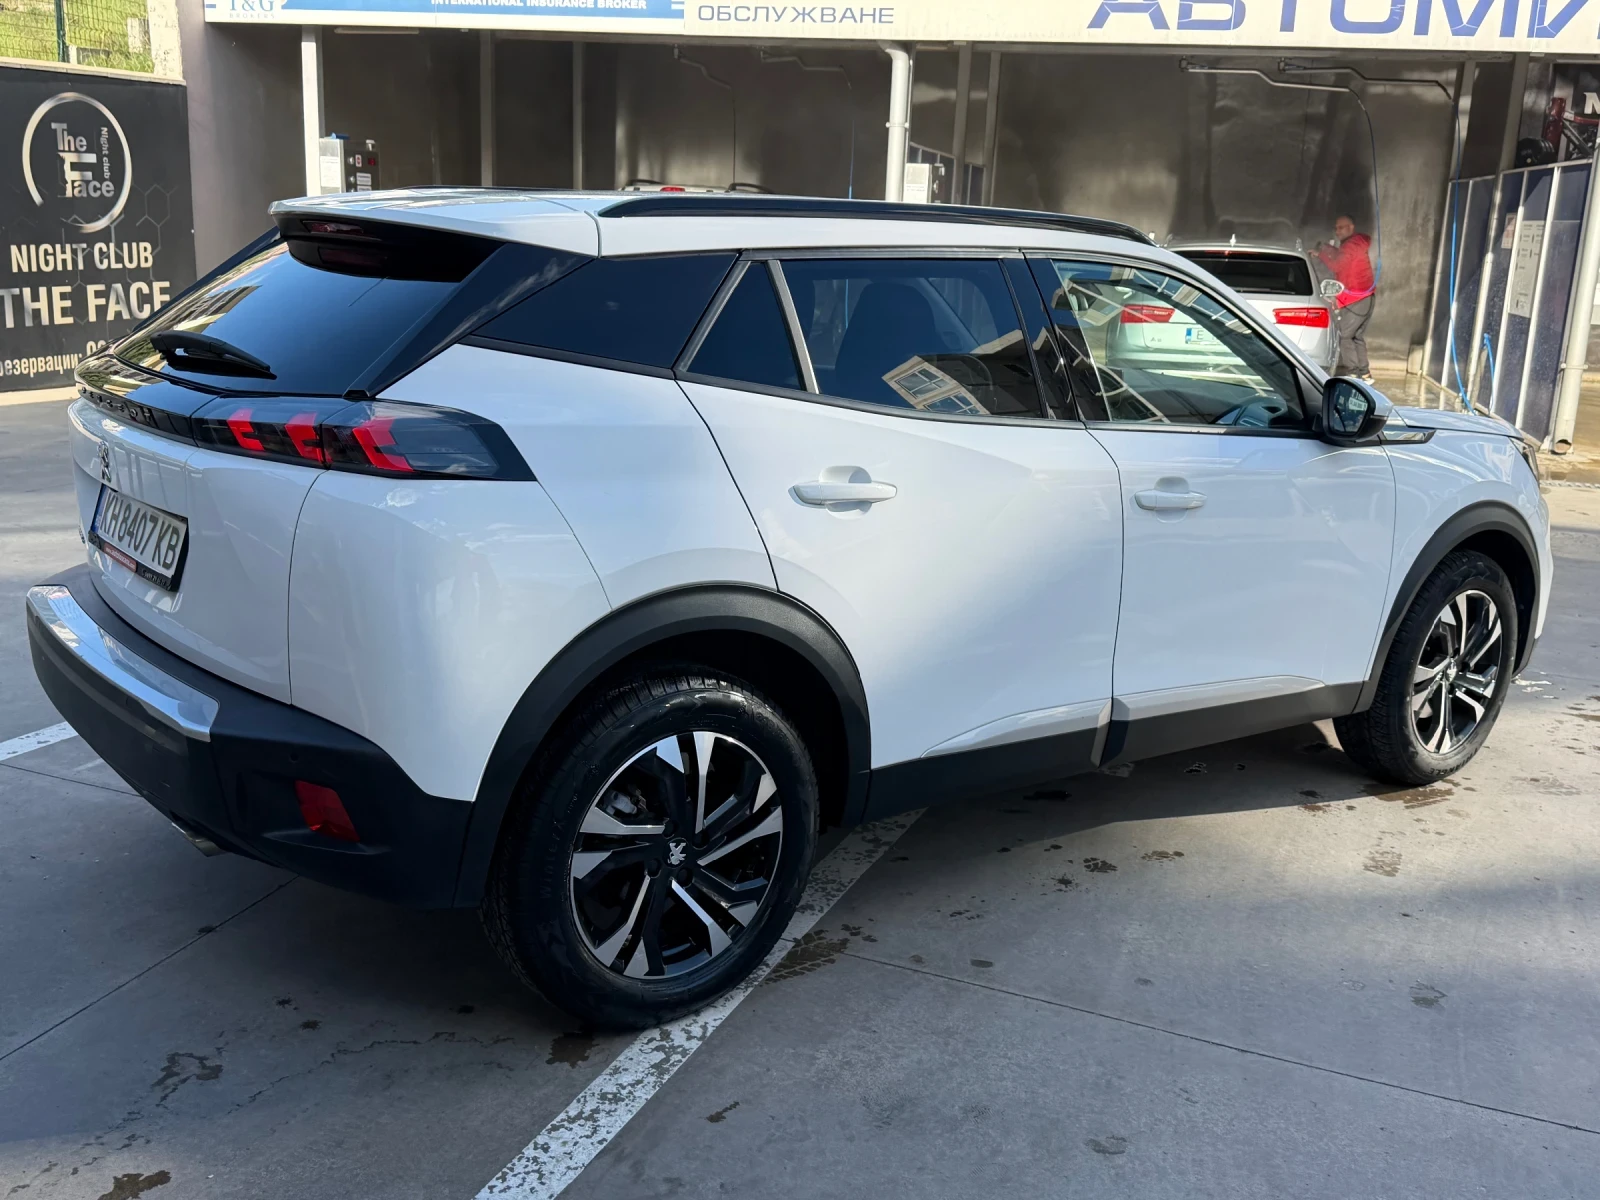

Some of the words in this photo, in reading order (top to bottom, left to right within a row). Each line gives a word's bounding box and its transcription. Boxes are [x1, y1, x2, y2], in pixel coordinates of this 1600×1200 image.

[697, 5, 895, 24] ОБСЛУЖВАНЕ
[51, 122, 87, 151] The
[100, 127, 109, 155] Night
[102, 157, 111, 179] club
[10, 243, 87, 273] NIGHT
[93, 241, 153, 270] CLUB
[0, 286, 74, 329] THE
[86, 281, 171, 323] FACE
